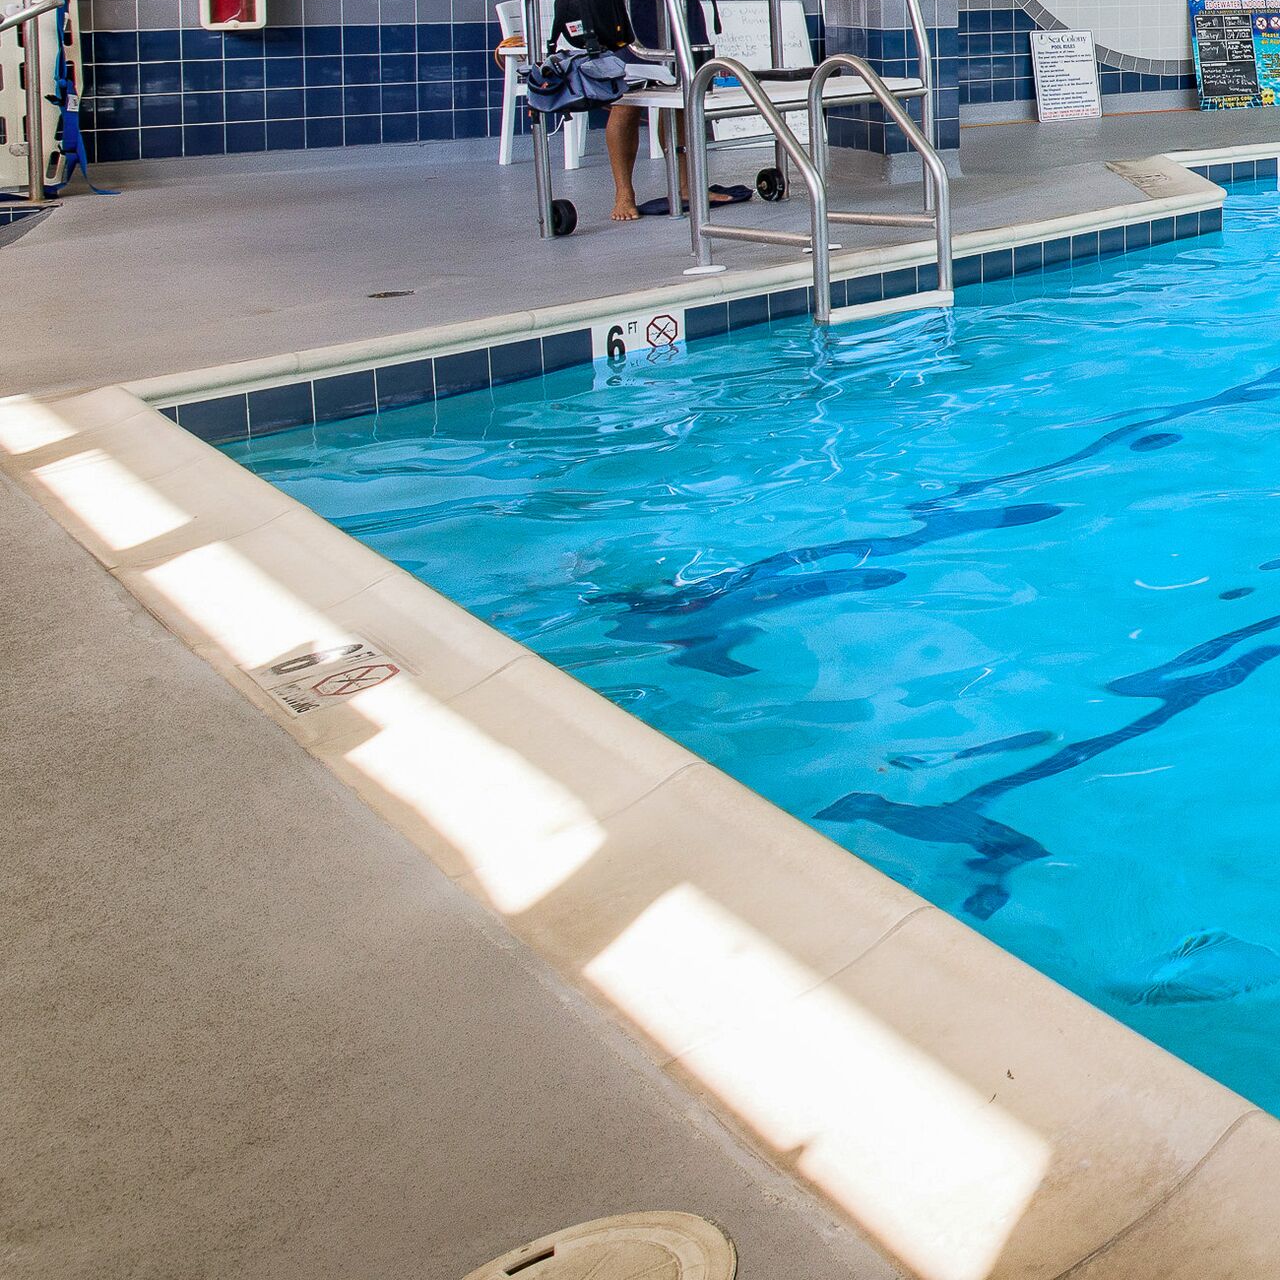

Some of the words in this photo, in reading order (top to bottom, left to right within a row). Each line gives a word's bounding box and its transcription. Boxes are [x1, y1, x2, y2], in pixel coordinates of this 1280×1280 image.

[1206, 0, 1241, 9] EDGEWATER
[1243, 0, 1265, 8] INDOOR
[1061, 34, 1087, 44] Colony
[607, 325, 626, 362] 6
[628, 321, 637, 335] FT
